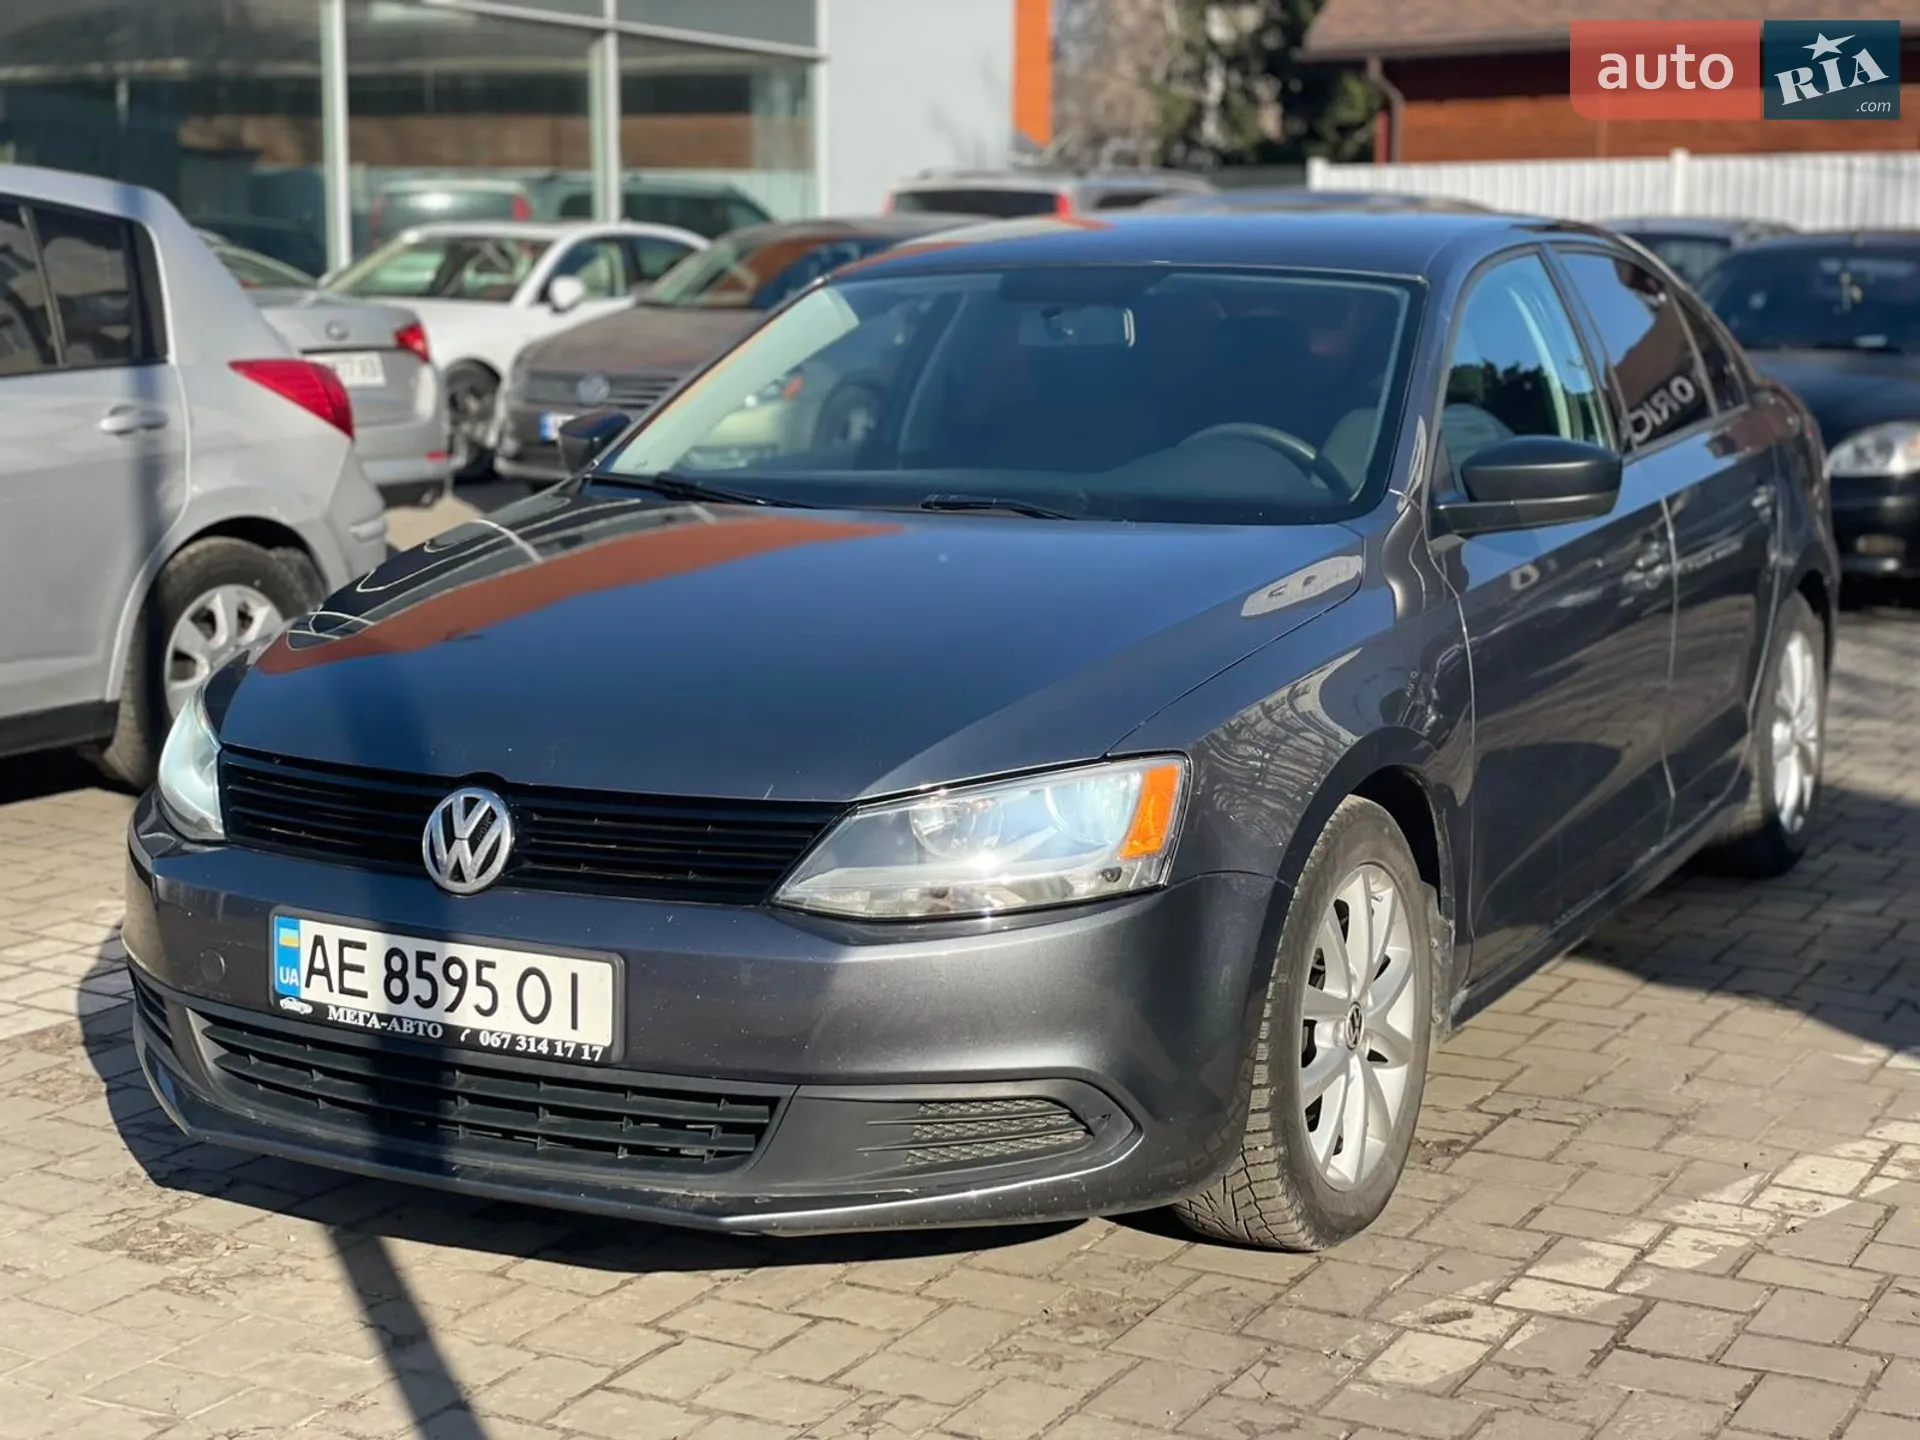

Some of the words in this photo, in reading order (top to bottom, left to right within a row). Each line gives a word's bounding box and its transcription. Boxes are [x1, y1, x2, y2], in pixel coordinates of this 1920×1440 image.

[279, 966, 300, 988] UA
[305, 934, 369, 999] AE
[384, 947, 498, 1017] 8595
[517, 966, 578, 1031] OI
[327, 1005, 443, 1039] МЕГА-АВТО
[479, 1029, 511, 1049] 067
[515, 1036, 549, 1055] 314
[554, 1040, 577, 1058] 17
[581, 1045, 604, 1062] 17
